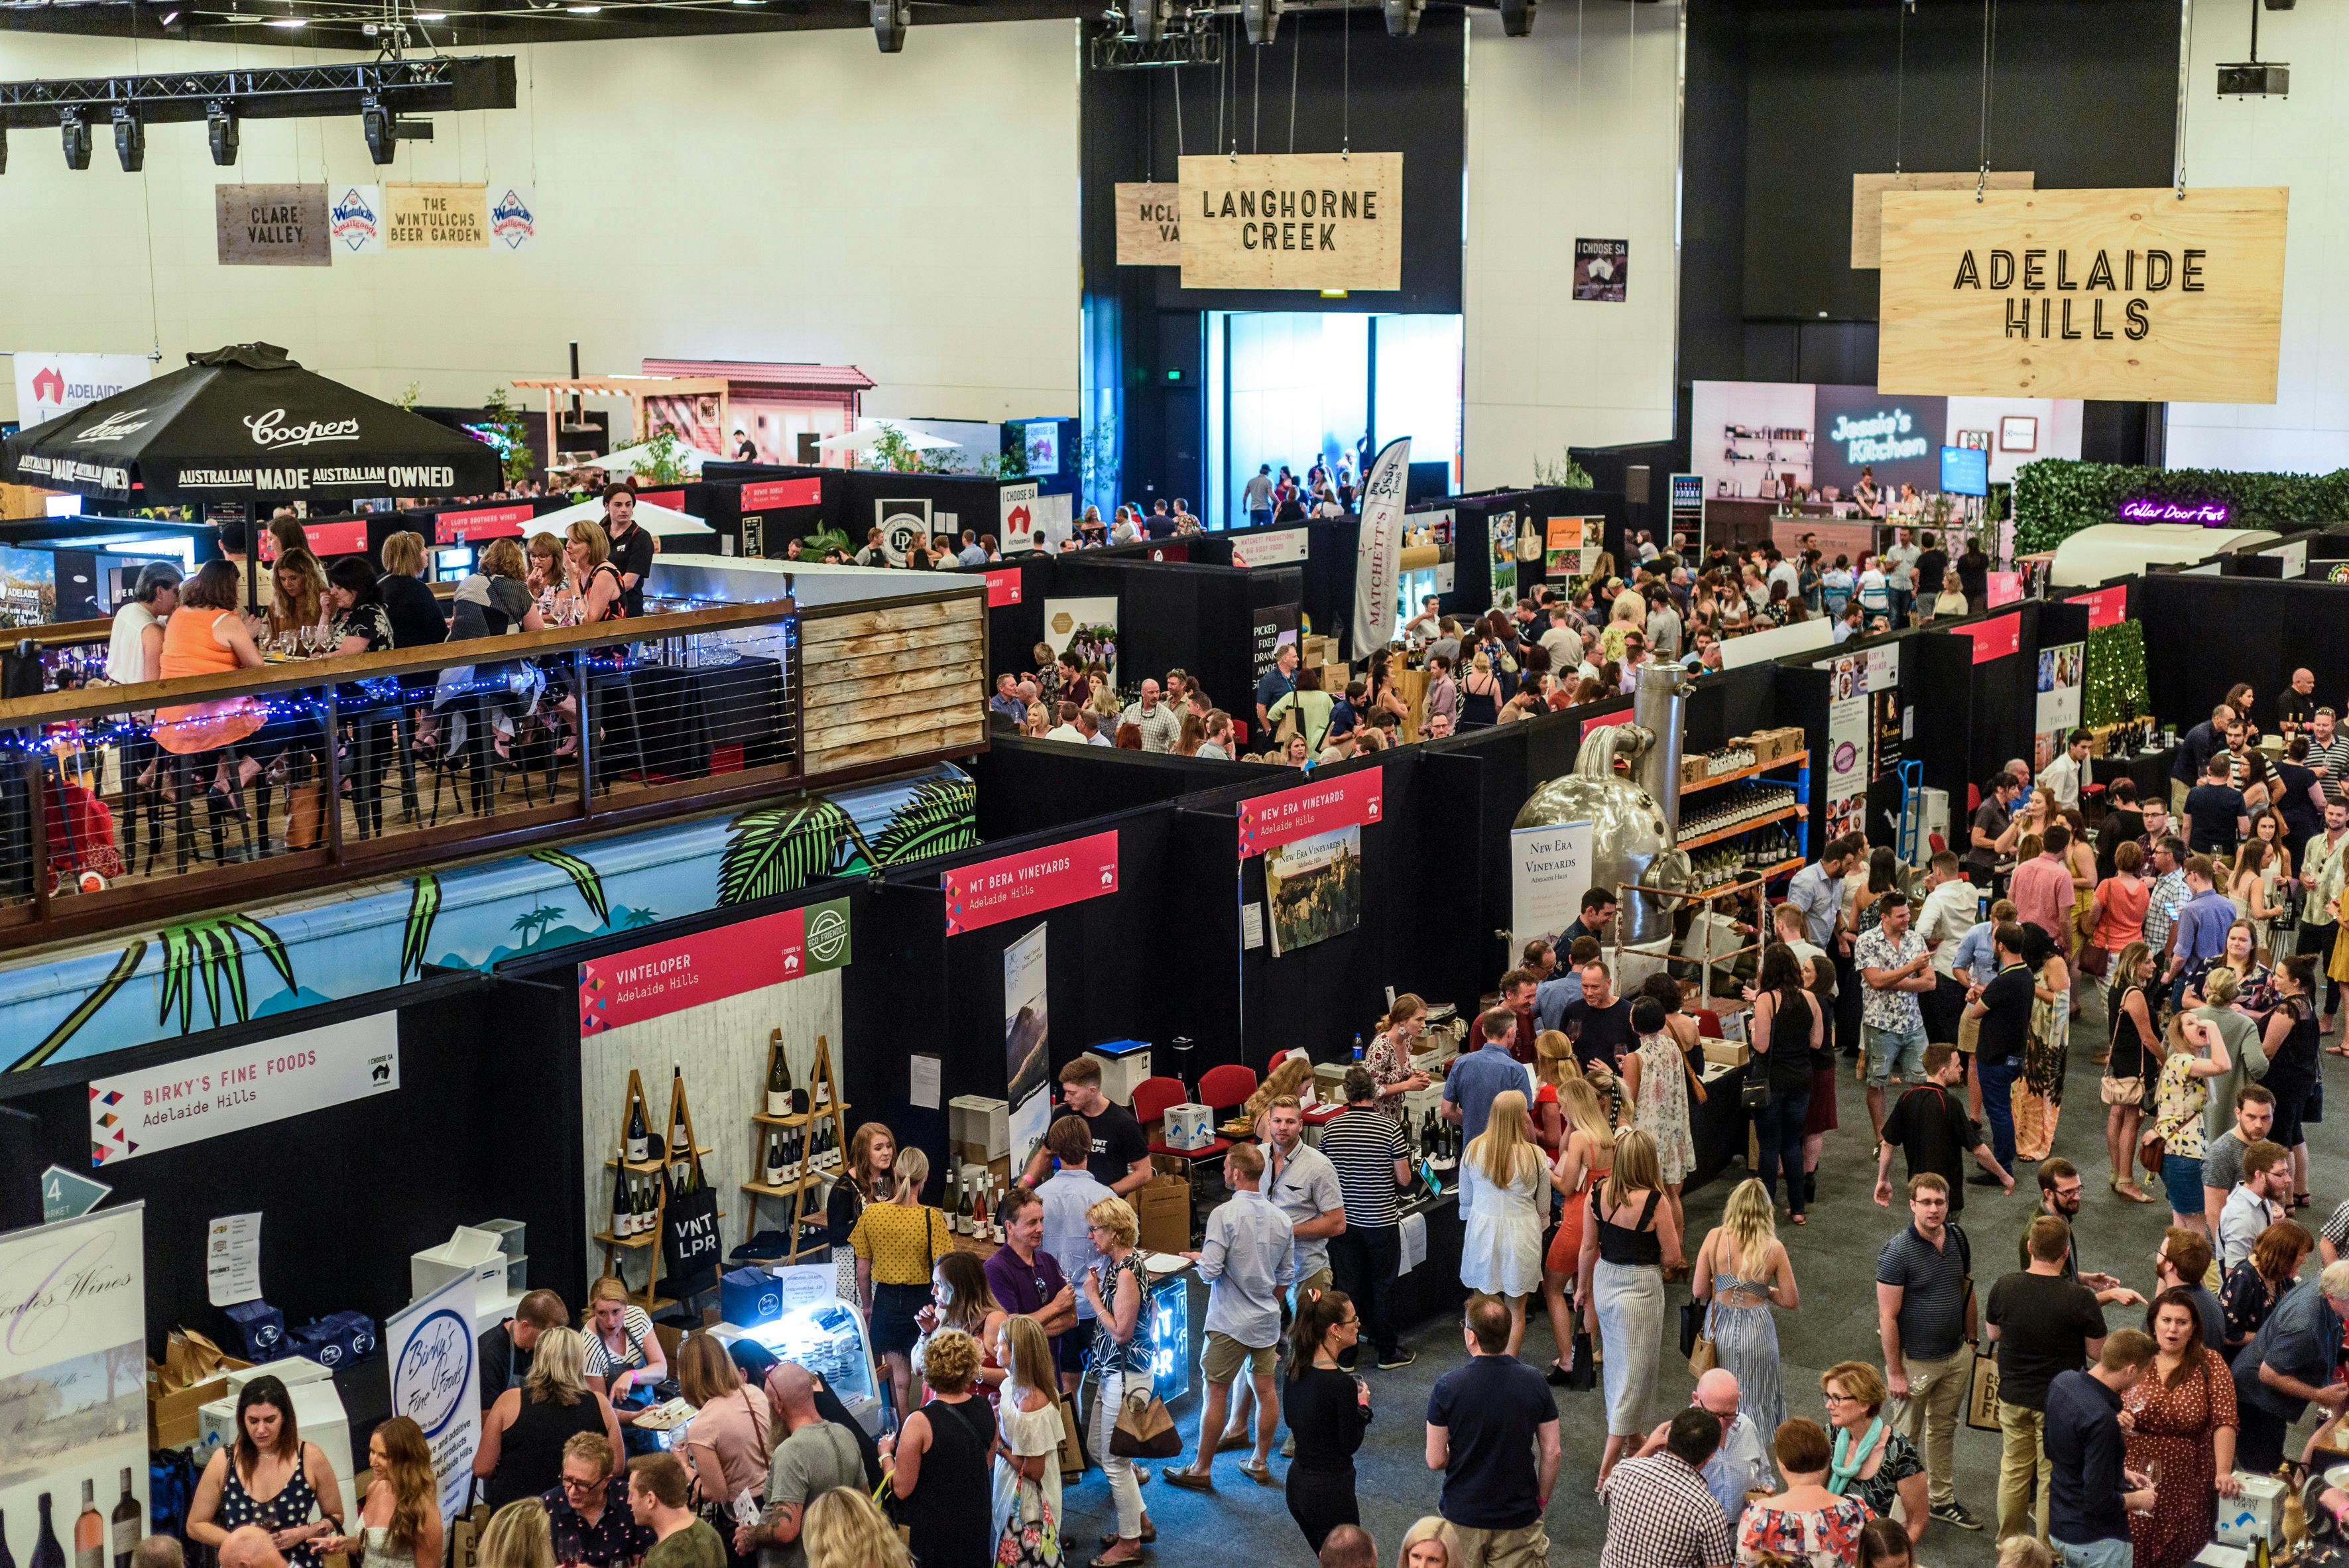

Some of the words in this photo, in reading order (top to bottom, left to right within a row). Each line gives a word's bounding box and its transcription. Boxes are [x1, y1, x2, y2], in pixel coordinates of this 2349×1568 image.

[251, 206, 298, 224] CLARE
[423, 198, 446, 211] THE
[1140, 204, 1180, 221] MCL
[1203, 190, 1378, 219] LANGHORNE
[333, 220, 377, 239] Smallgoods
[395, 213, 475, 226] WINTULICHS
[248, 226, 303, 243] VALLEY
[391, 228, 423, 241] BEER
[432, 228, 481, 241] GARDEN
[1242, 222, 1336, 250] CREEK
[1583, 243, 1613, 255] CHOOSE
[1615, 243, 1626, 255] SA
[1953, 249, 2206, 291] ADELAIDE
[2006, 298, 2149, 341] HILLS
[243, 408, 360, 446] Coopers
[1832, 408, 1912, 441] Jessie's
[1848, 436, 1927, 463] Kitchen
[178, 469, 252, 485] AUSTRALIAN
[256, 468, 311, 490] MADE
[312, 467, 385, 481] AUSTRALIAN
[389, 466, 454, 487] OWNED
[1006, 490, 1027, 502] CHOOSE
[1028, 488, 1035, 499] SA
[2124, 503, 2162, 517] Cellar
[2164, 505, 2196, 519] Door
[2198, 506, 2225, 520] Fest
[1369, 511, 1387, 627] MATCHETT'S
[8, 587, 38, 599] ADELAIDE
[1254, 623, 1277, 636] PICKED
[1258, 637, 1276, 649] FIXED
[1262, 806, 1278, 821] NEW
[1284, 802, 1298, 815] ERA
[1302, 790, 1344, 810] VINEYARDS
[1260, 820, 1292, 836] Adelaide
[1295, 814, 1315, 827] Hills
[970, 878, 984, 893] MT
[989, 872, 1014, 889] BERA
[1018, 857, 1070, 880] VINEYARDS
[1526, 859, 1576, 873] VINEYARDS
[969, 893, 1006, 910] Adelaide
[1011, 885, 1034, 899] Hills
[808, 937, 819, 948] ECO
[820, 924, 847, 943] FRIENDLY
[784, 946, 796, 955] CHOOSE
[617, 954, 691, 985] VINTELOPER
[617, 983, 664, 1004] Adelaide
[670, 973, 699, 989] Hills
[371, 1055, 386, 1065] CHOOSE
[143, 1076, 210, 1106] BIRKY'S
[221, 1064, 257, 1087] FINE
[267, 1050, 317, 1076] FOODS
[143, 1101, 208, 1128] Adelaide
[217, 1089, 257, 1109] Hills
[47, 1178, 62, 1201] 4
[676, 1213, 711, 1238] VNT
[680, 1235, 716, 1259] LPR
[66, 1264, 133, 1301] Wines
[409, 1322, 455, 1390] Birky's
[437, 1355, 463, 1399] Foods
[406, 1389, 430, 1417] Fine
[438, 1435, 448, 1450] and
[449, 1419, 471, 1441] additive
[444, 1437, 467, 1462] products
[436, 1457, 459, 1480] Adelaide
[460, 1446, 472, 1461] Hills
[2234, 1500, 2257, 1512] LOFTY
